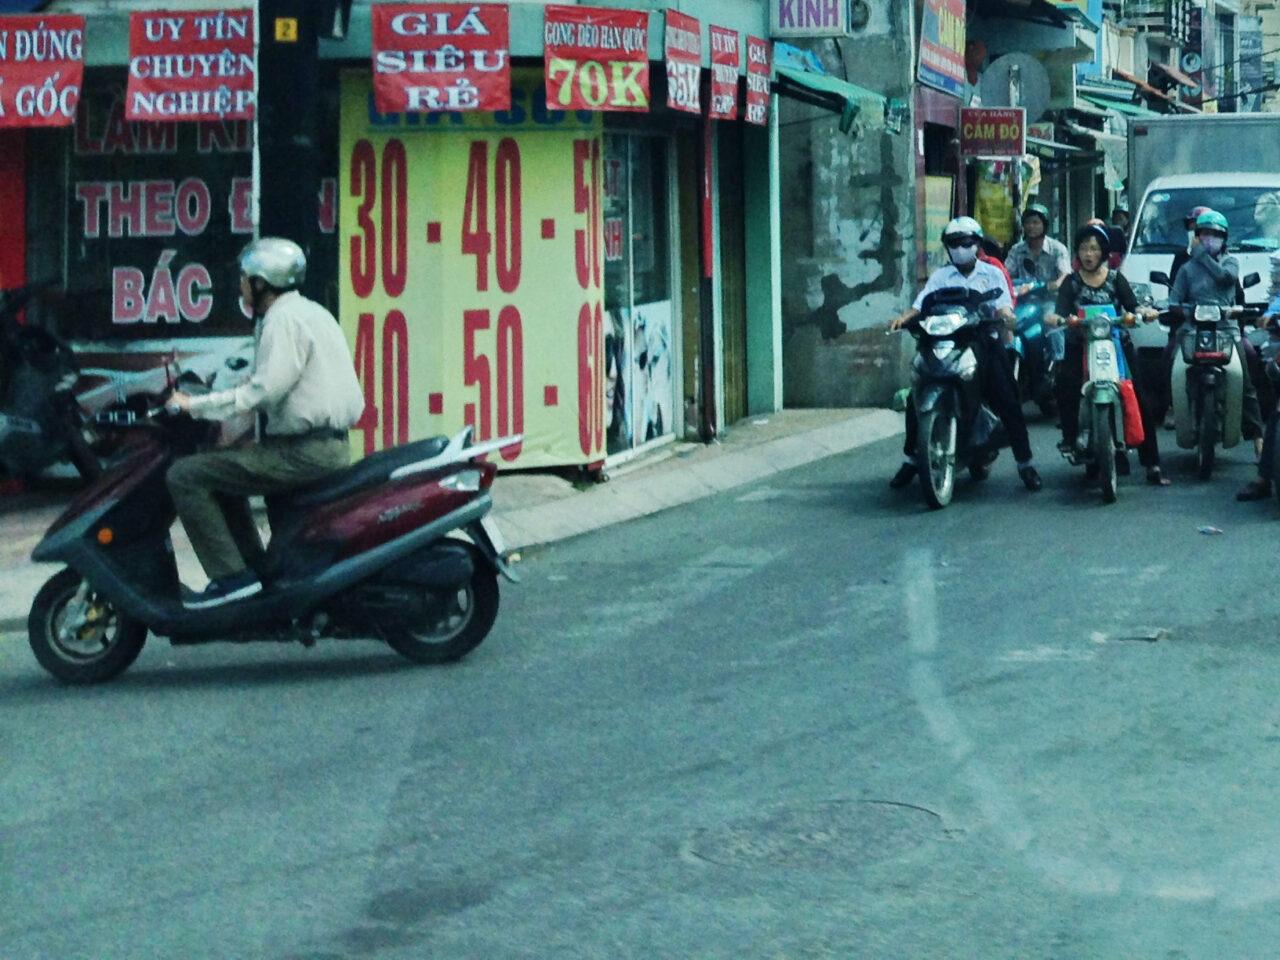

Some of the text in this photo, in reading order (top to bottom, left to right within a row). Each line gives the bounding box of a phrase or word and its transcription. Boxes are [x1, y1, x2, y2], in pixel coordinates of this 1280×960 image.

[15, 21, 82, 61] ĐÚNG
[144, 10, 247, 41] UY TÍN
[391, 7, 490, 36] GIÁ
[130, 49, 255, 79] CHUYÊN
[376, 44, 508, 73] SIÊU
[15, 72, 78, 117] GỐC
[132, 85, 257, 118] NGHIỆP
[404, 78, 479, 110] RẺ
[549, 57, 649, 107] 70K
[75, 177, 211, 238] THEO
[351, 138, 408, 298] 30
[461, 137, 521, 293] 40
[112, 249, 213, 324] BÁC
[352, 309, 409, 457] 40
[463, 305, 524, 461] 50
